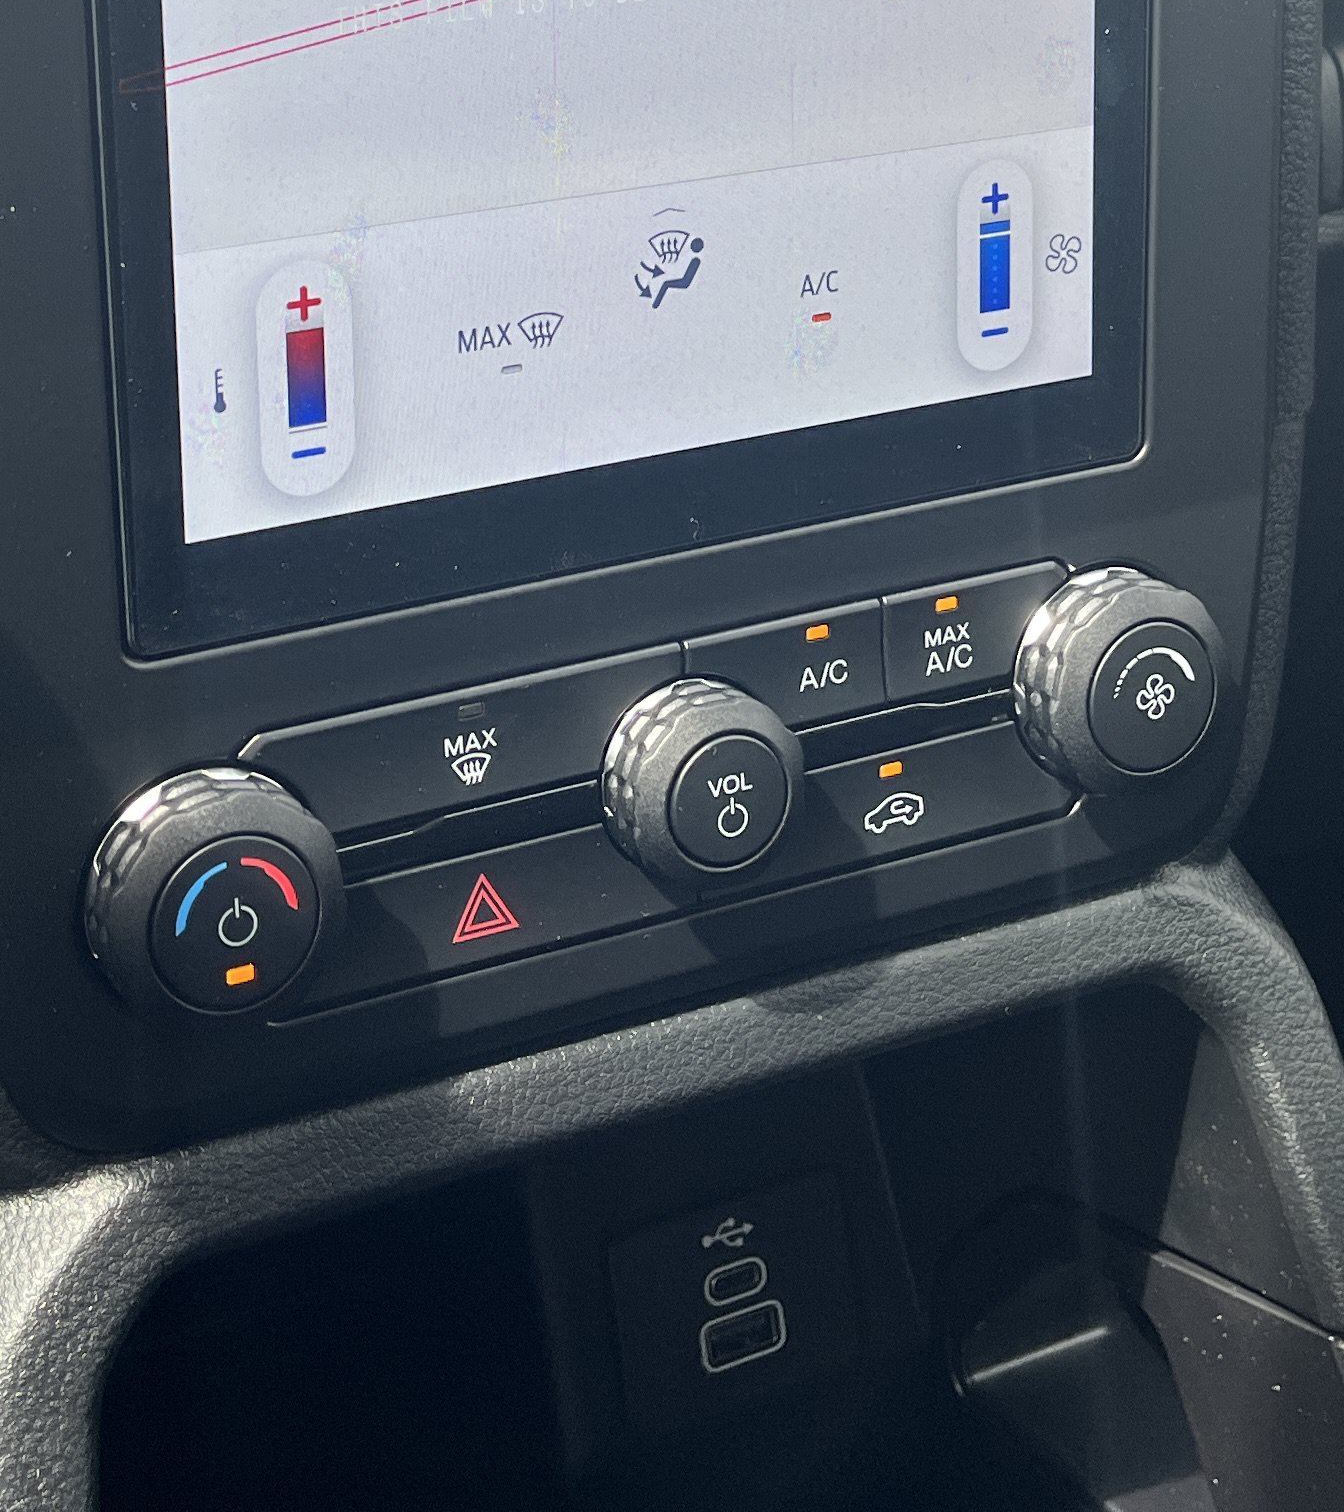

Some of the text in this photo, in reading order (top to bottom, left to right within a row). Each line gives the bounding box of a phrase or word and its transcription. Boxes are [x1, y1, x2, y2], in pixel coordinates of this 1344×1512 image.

[337, 1, 402, 34] THIS
[800, 270, 839, 298] A/C
[458, 322, 512, 354] MAX
[924, 622, 971, 649] MAX
[799, 658, 848, 693] A/C
[925, 644, 974, 677] A/C
[443, 728, 498, 760] MAX
[707, 773, 754, 799] VOL
